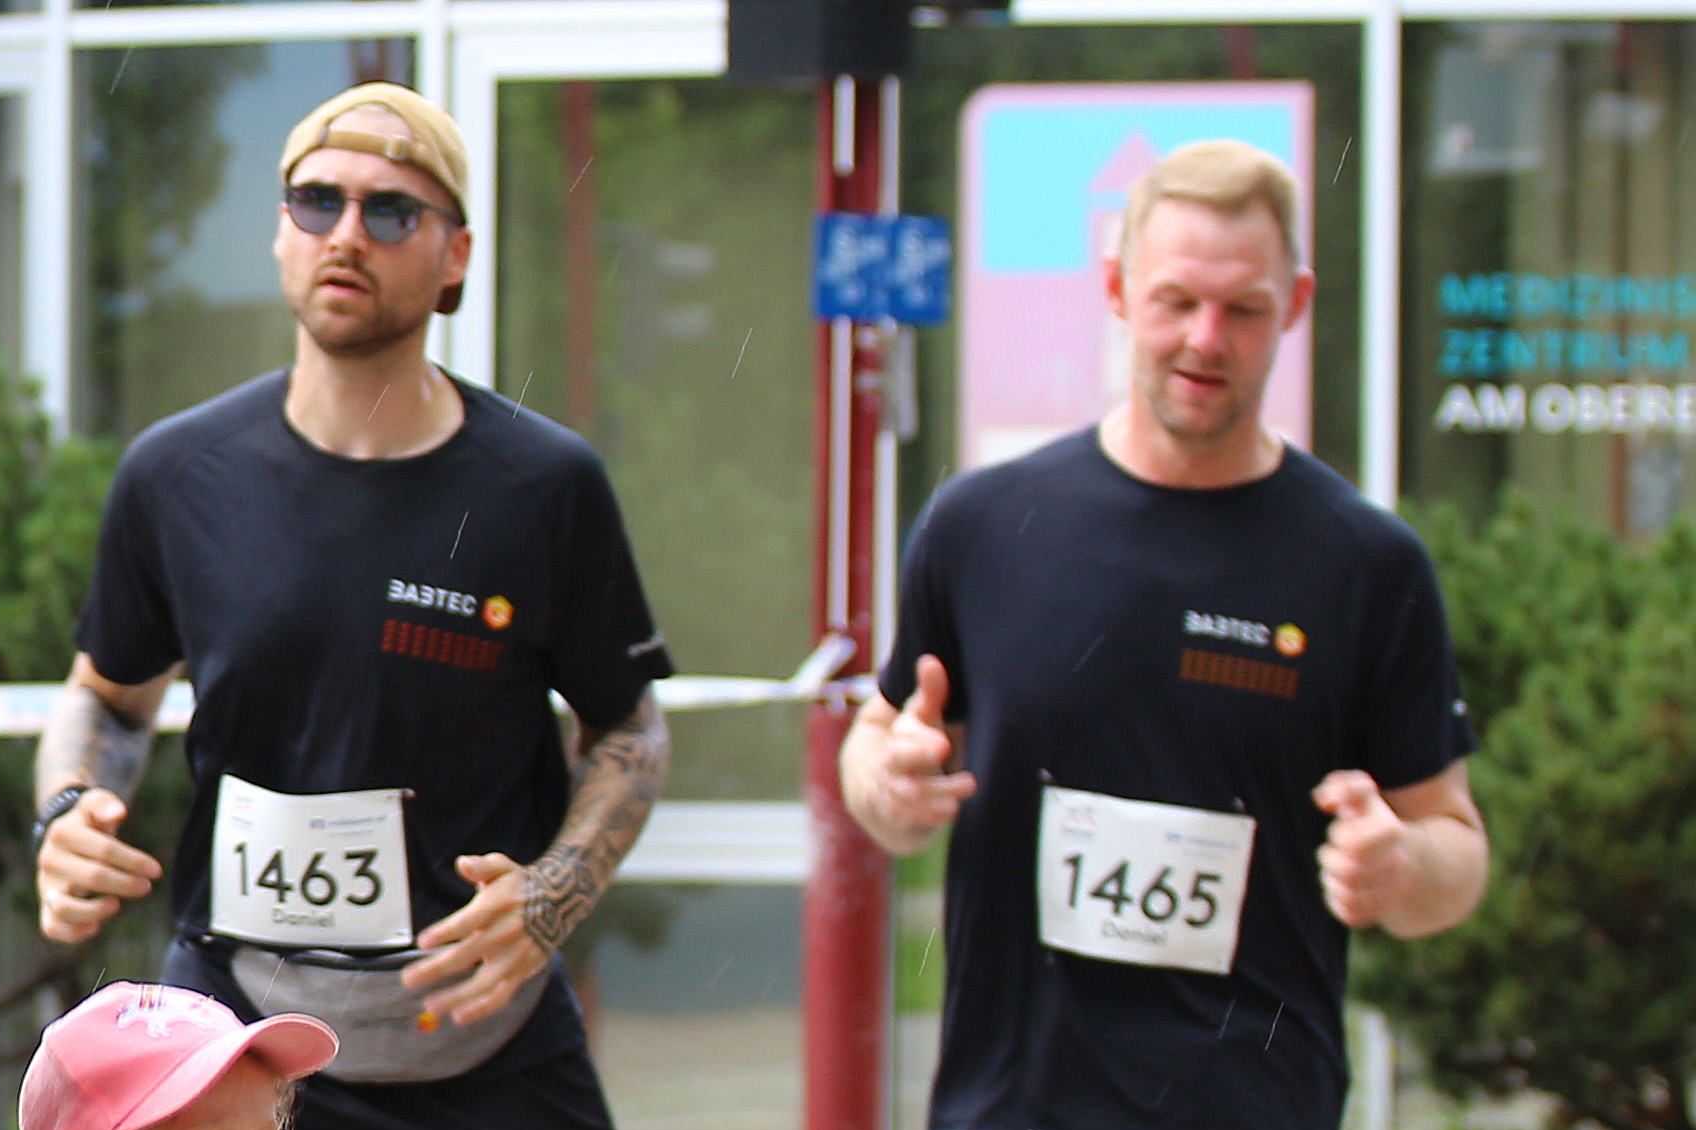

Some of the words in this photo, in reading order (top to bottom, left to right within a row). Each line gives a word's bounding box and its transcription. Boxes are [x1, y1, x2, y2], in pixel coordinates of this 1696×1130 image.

[1438, 329, 1689, 376] ZENTRUM
[1433, 382, 1528, 433] AM
[234, 842, 384, 907] 1463
[1062, 852, 1223, 929] 1465
